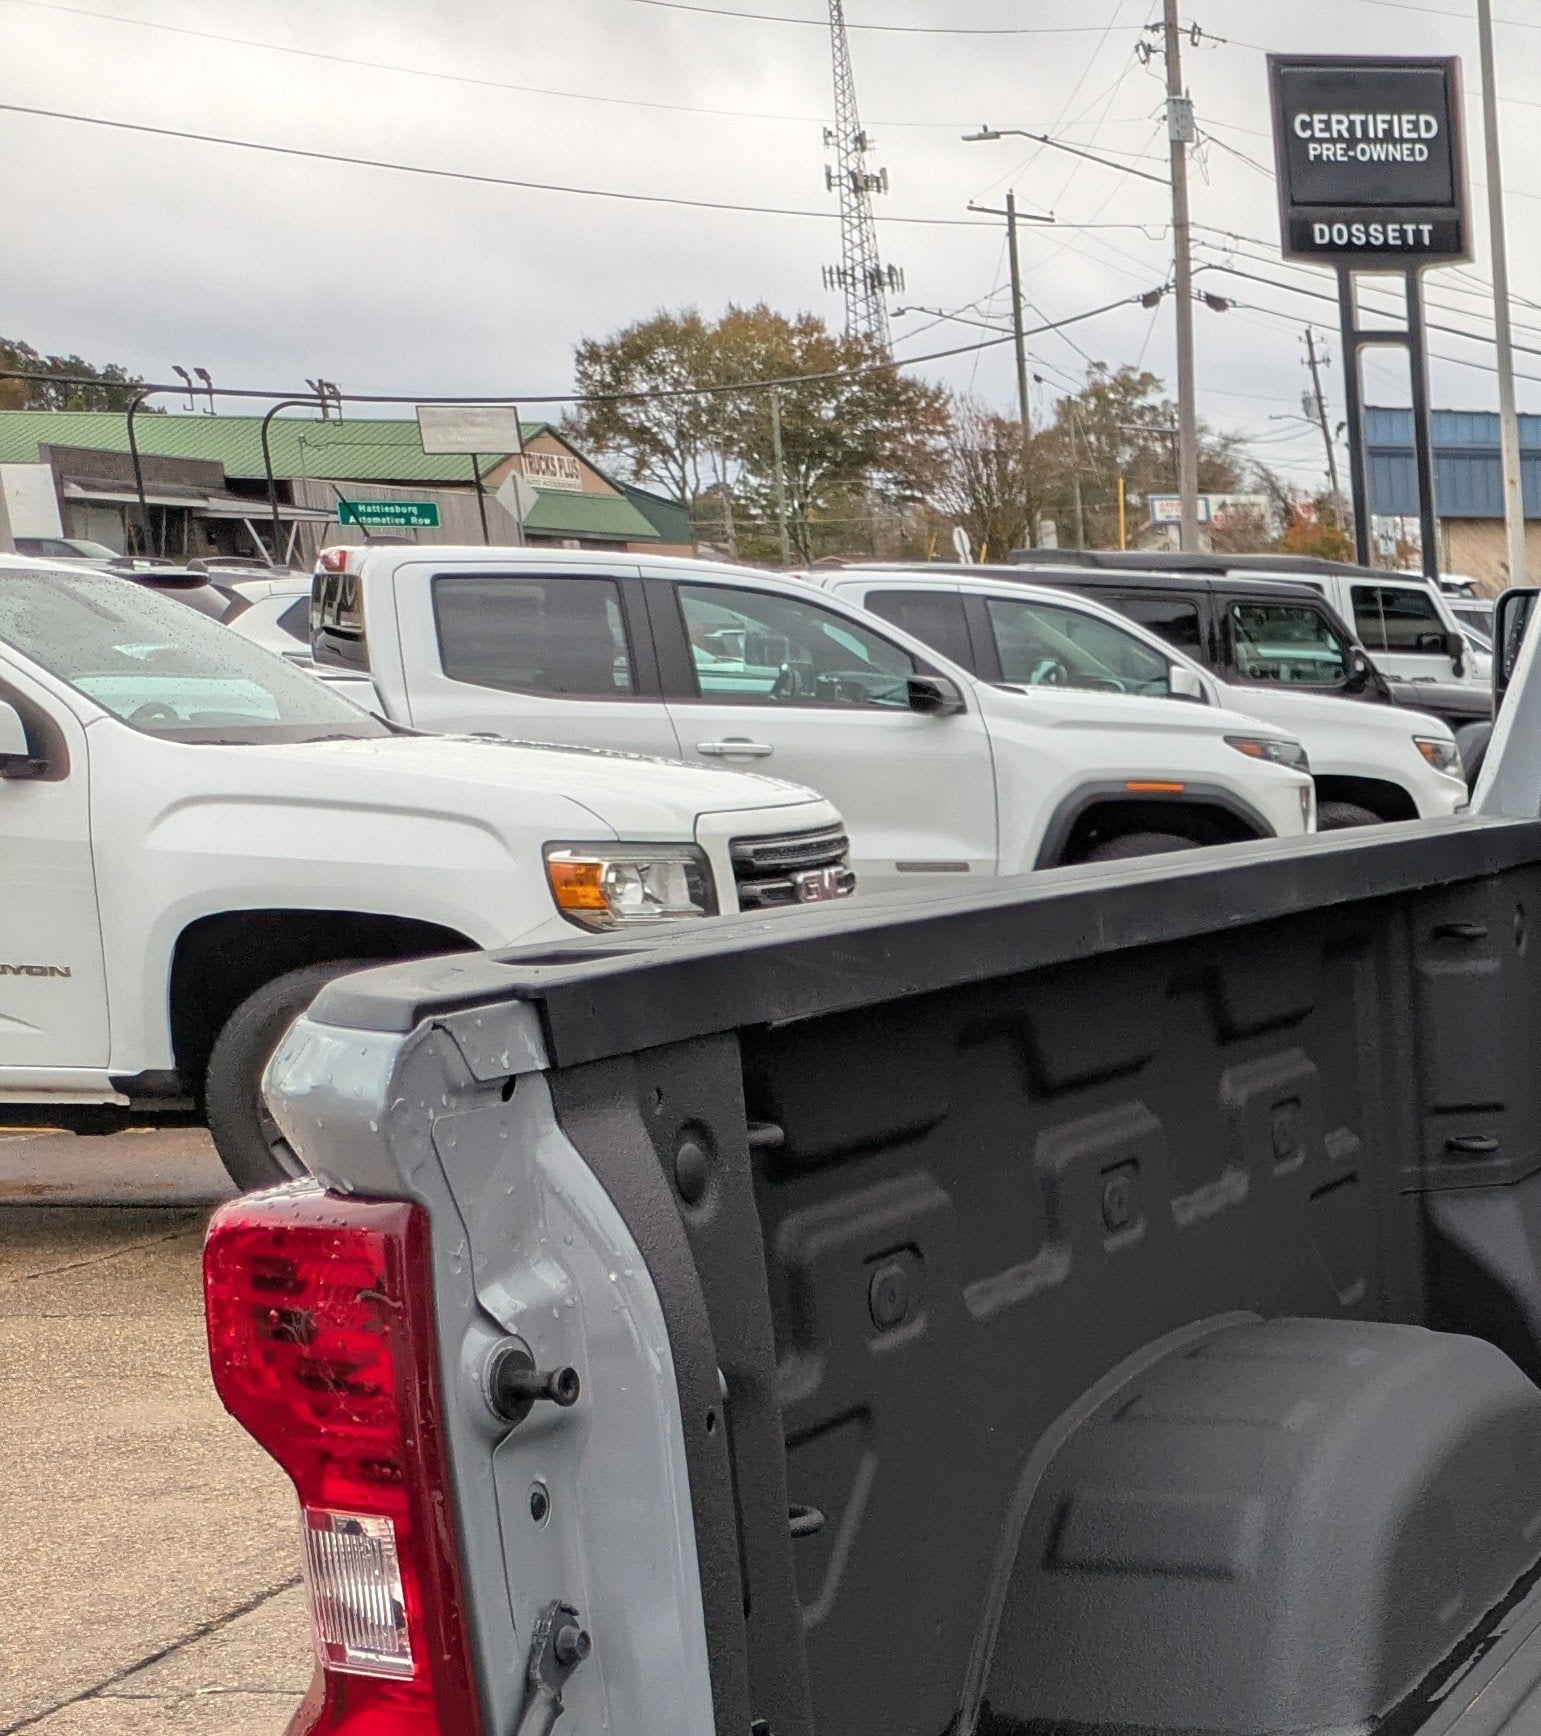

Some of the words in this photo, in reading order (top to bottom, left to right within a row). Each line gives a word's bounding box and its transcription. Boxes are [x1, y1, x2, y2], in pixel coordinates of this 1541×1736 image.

[1294, 113, 1439, 139] CERTIFIED
[1308, 143, 1429, 162] PRE-OWNED
[1313, 223, 1434, 246] DOSSETT
[358, 504, 418, 515] Hattiesburg
[410, 516, 431, 525] Row
